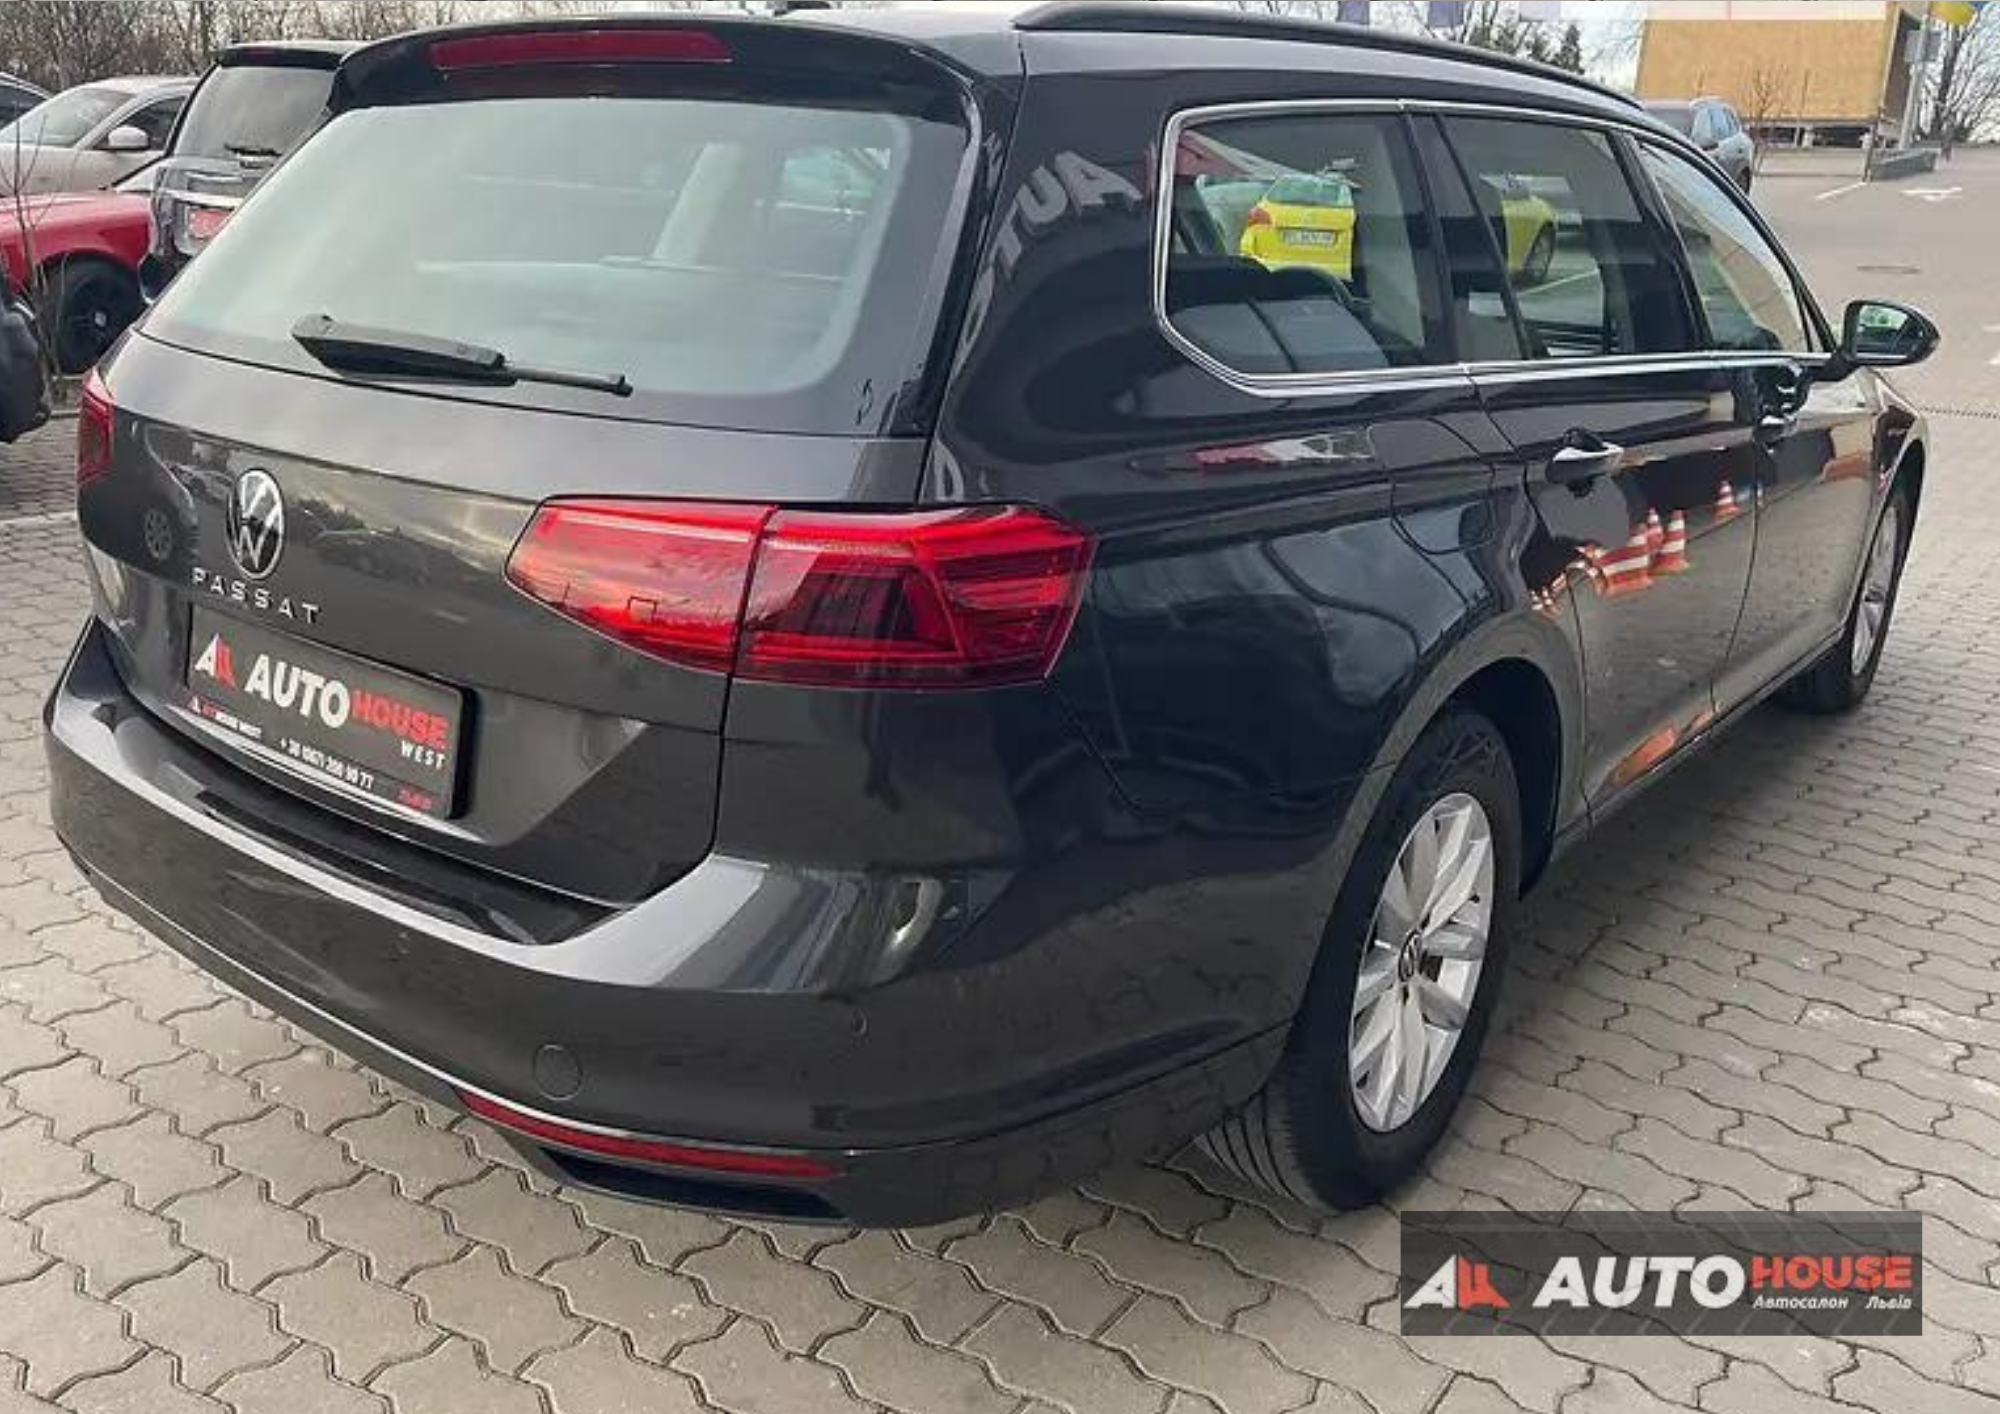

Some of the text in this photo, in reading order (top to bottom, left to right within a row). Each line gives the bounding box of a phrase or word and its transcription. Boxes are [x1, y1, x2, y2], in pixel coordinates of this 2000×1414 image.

[192, 566, 320, 624] PASSAT
[244, 653, 351, 728] AUTO
[351, 689, 448, 750] HOUSE
[401, 740, 446, 770] WEST
